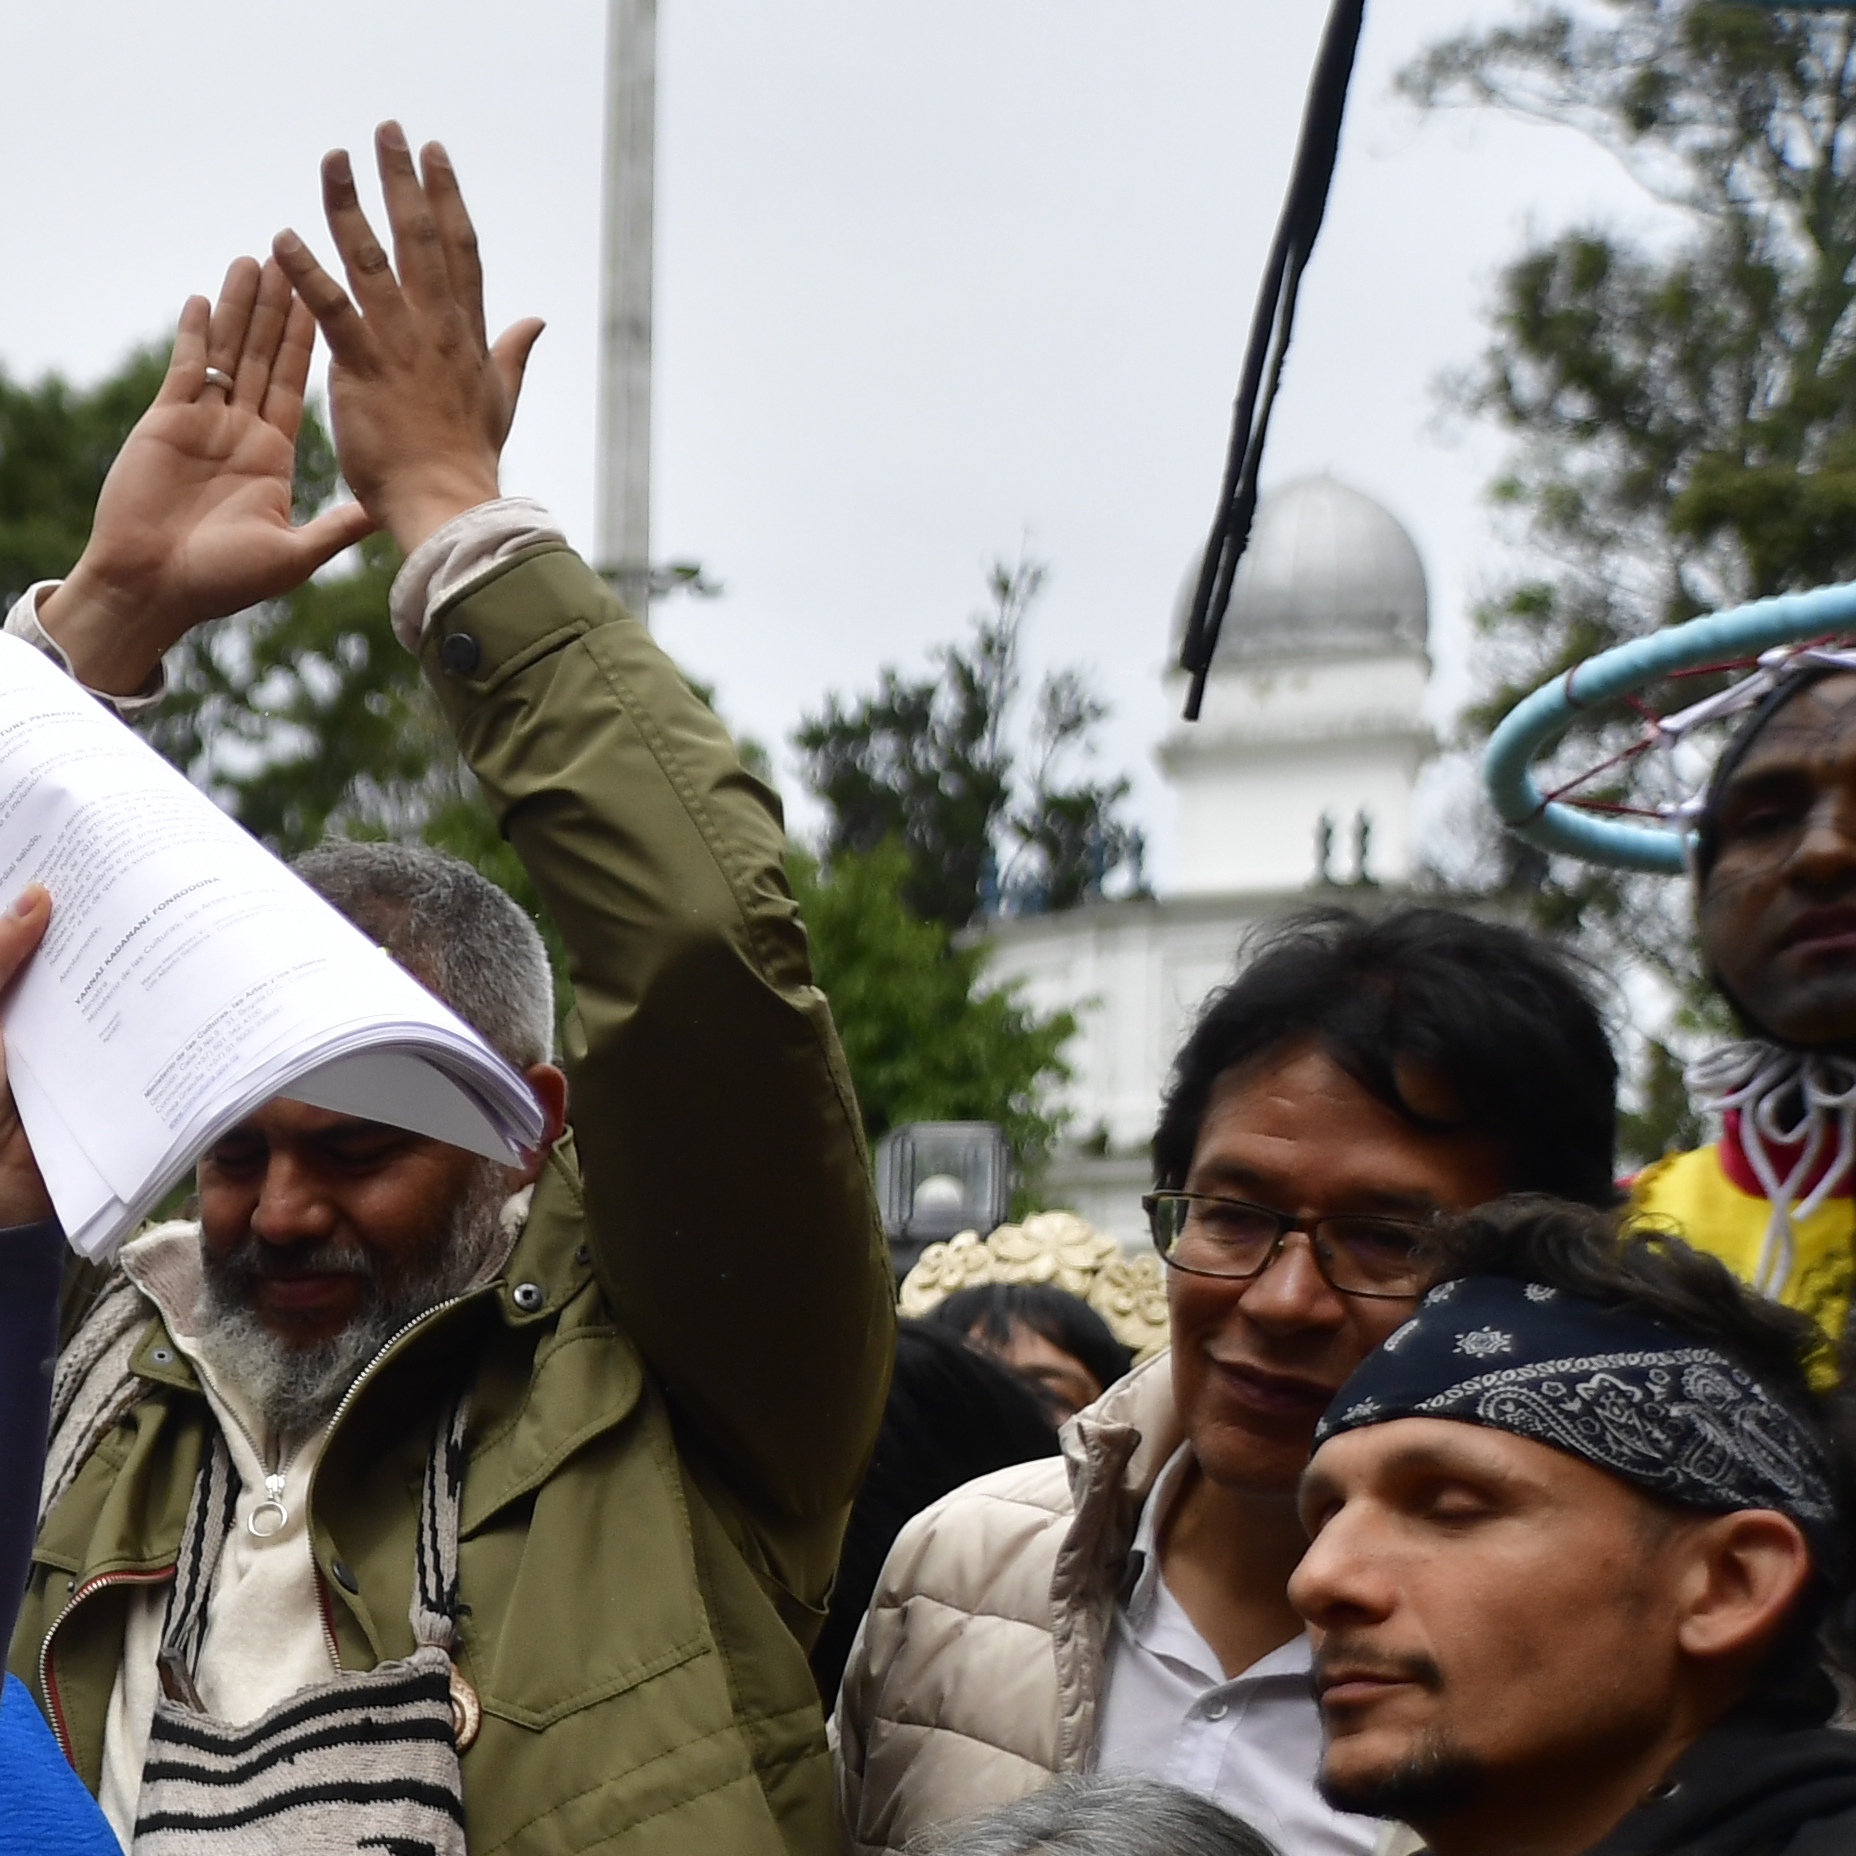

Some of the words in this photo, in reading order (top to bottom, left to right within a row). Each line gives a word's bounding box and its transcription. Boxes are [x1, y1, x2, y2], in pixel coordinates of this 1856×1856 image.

[14, 833, 43, 864] saludo,
[73, 964, 105, 1005] YANNAI
[102, 913, 152, 967] KADAMANI
[150, 876, 221, 916] FONRODONA
